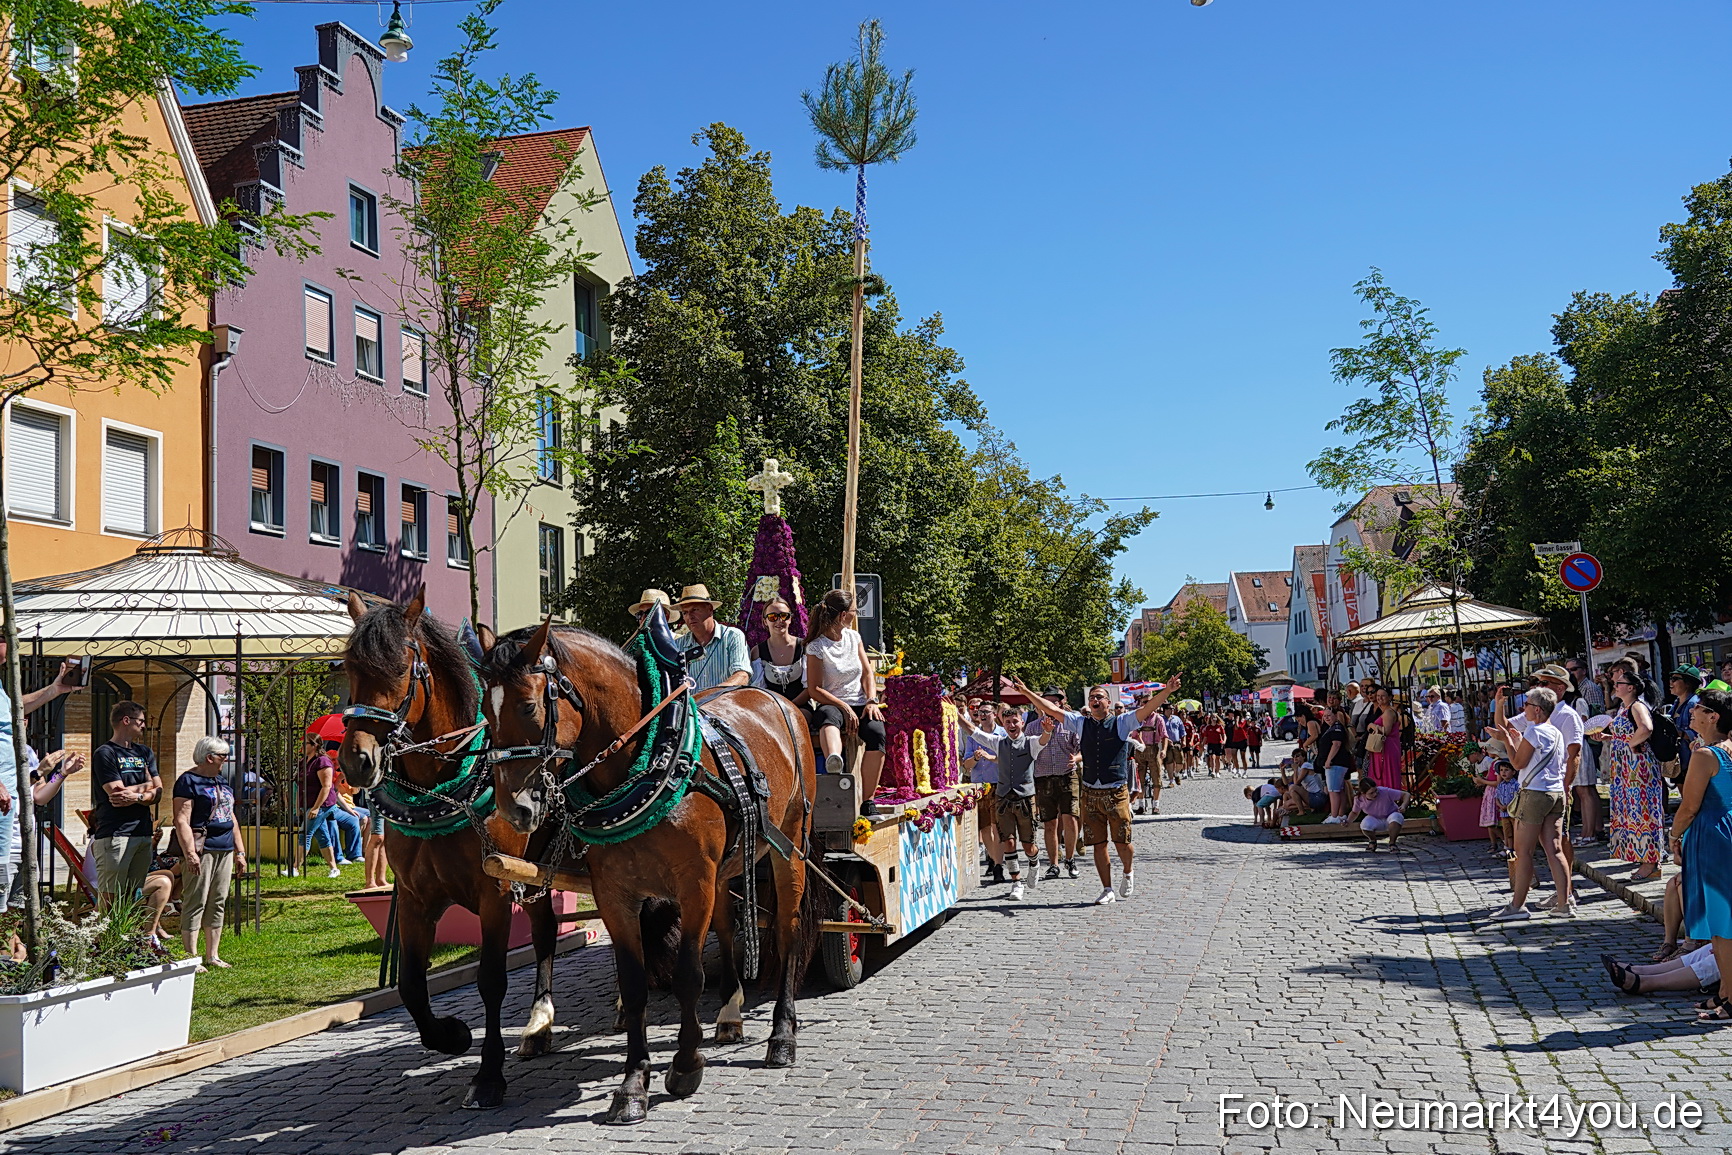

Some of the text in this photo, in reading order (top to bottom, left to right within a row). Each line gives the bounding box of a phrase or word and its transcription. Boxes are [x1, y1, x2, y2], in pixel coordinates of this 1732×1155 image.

[1538, 544, 1573, 553] Ulmer Gasse
[1344, 587, 1358, 622] SALE
